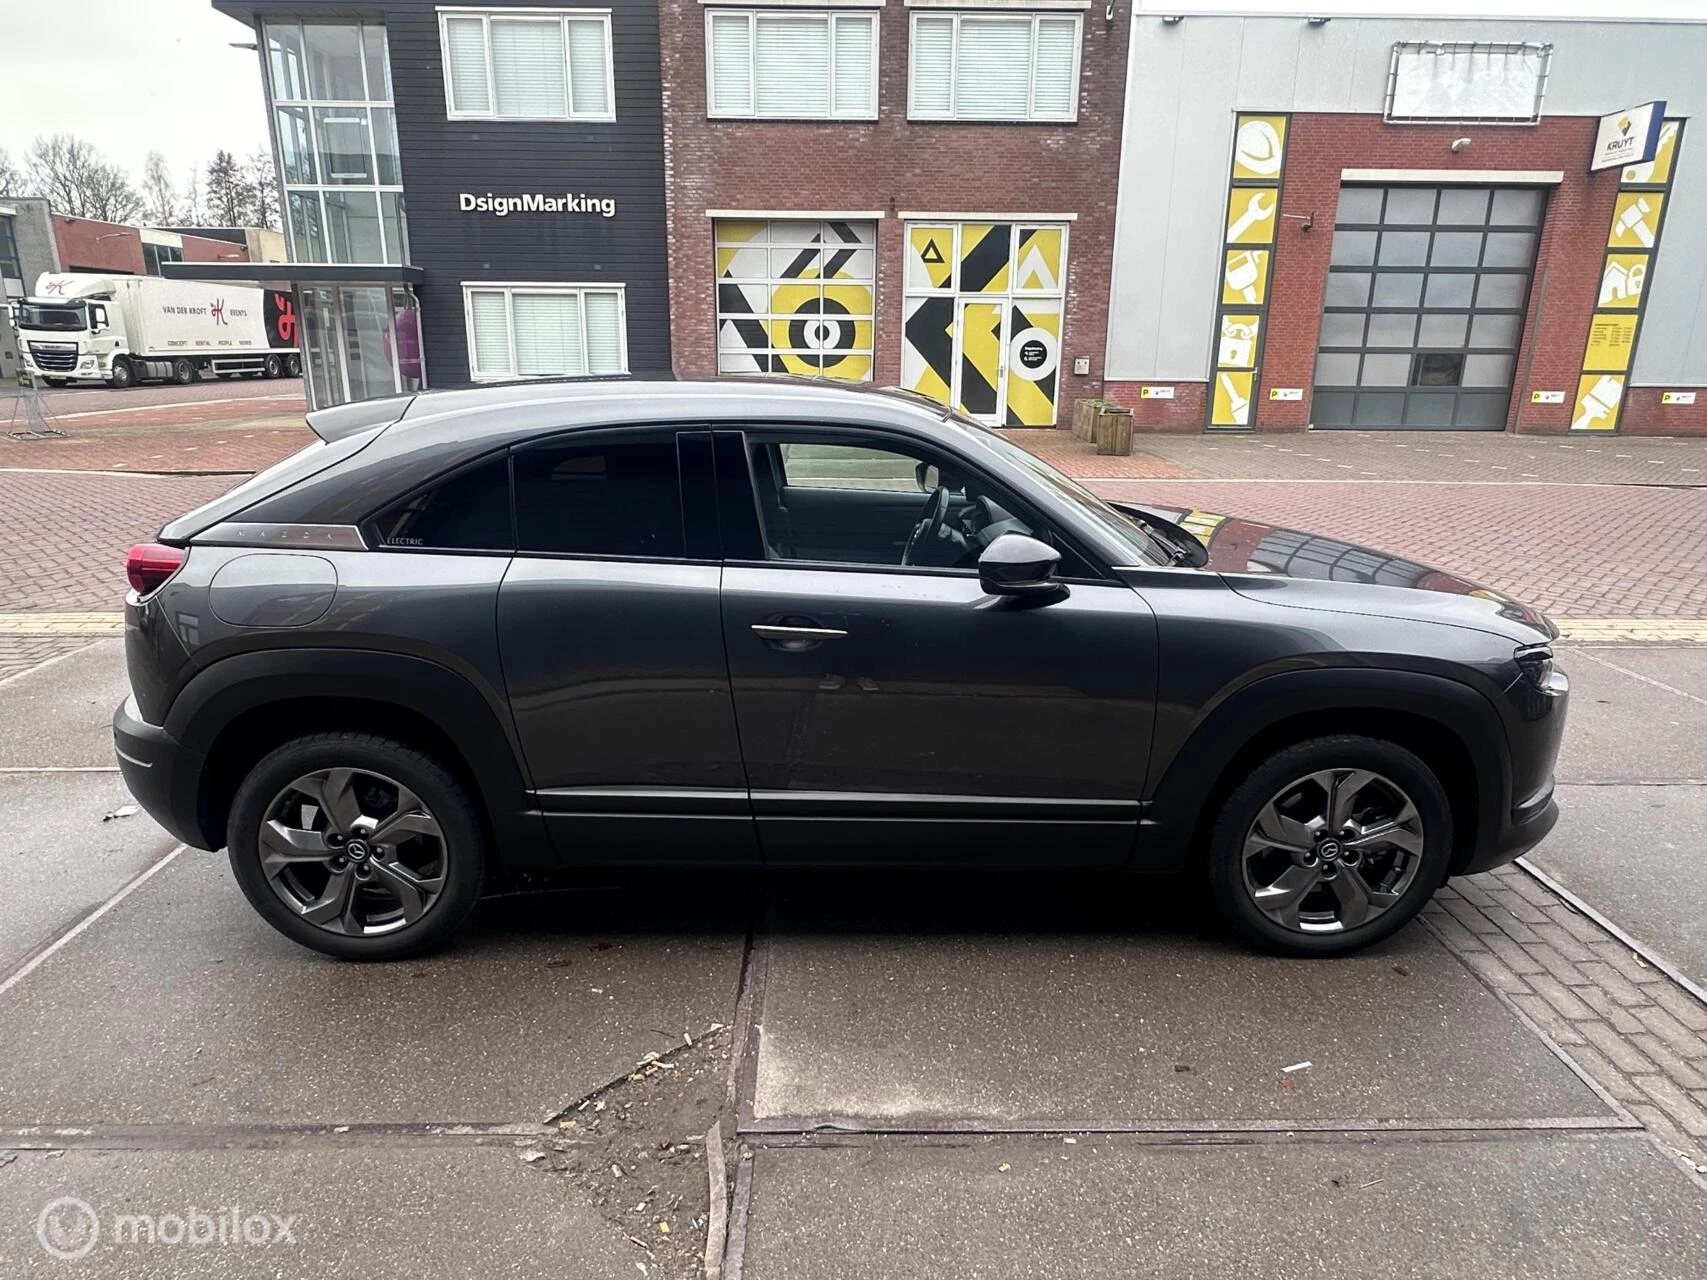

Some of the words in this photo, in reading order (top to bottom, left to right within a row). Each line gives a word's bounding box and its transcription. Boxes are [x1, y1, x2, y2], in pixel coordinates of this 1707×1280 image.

[1607, 136, 1634, 150] KRUYT
[459, 193, 616, 217] DsignMarking
[163, 306, 175, 314] VAN
[189, 307, 207, 315] KROFT
[386, 537, 424, 546] ELECTRIC
